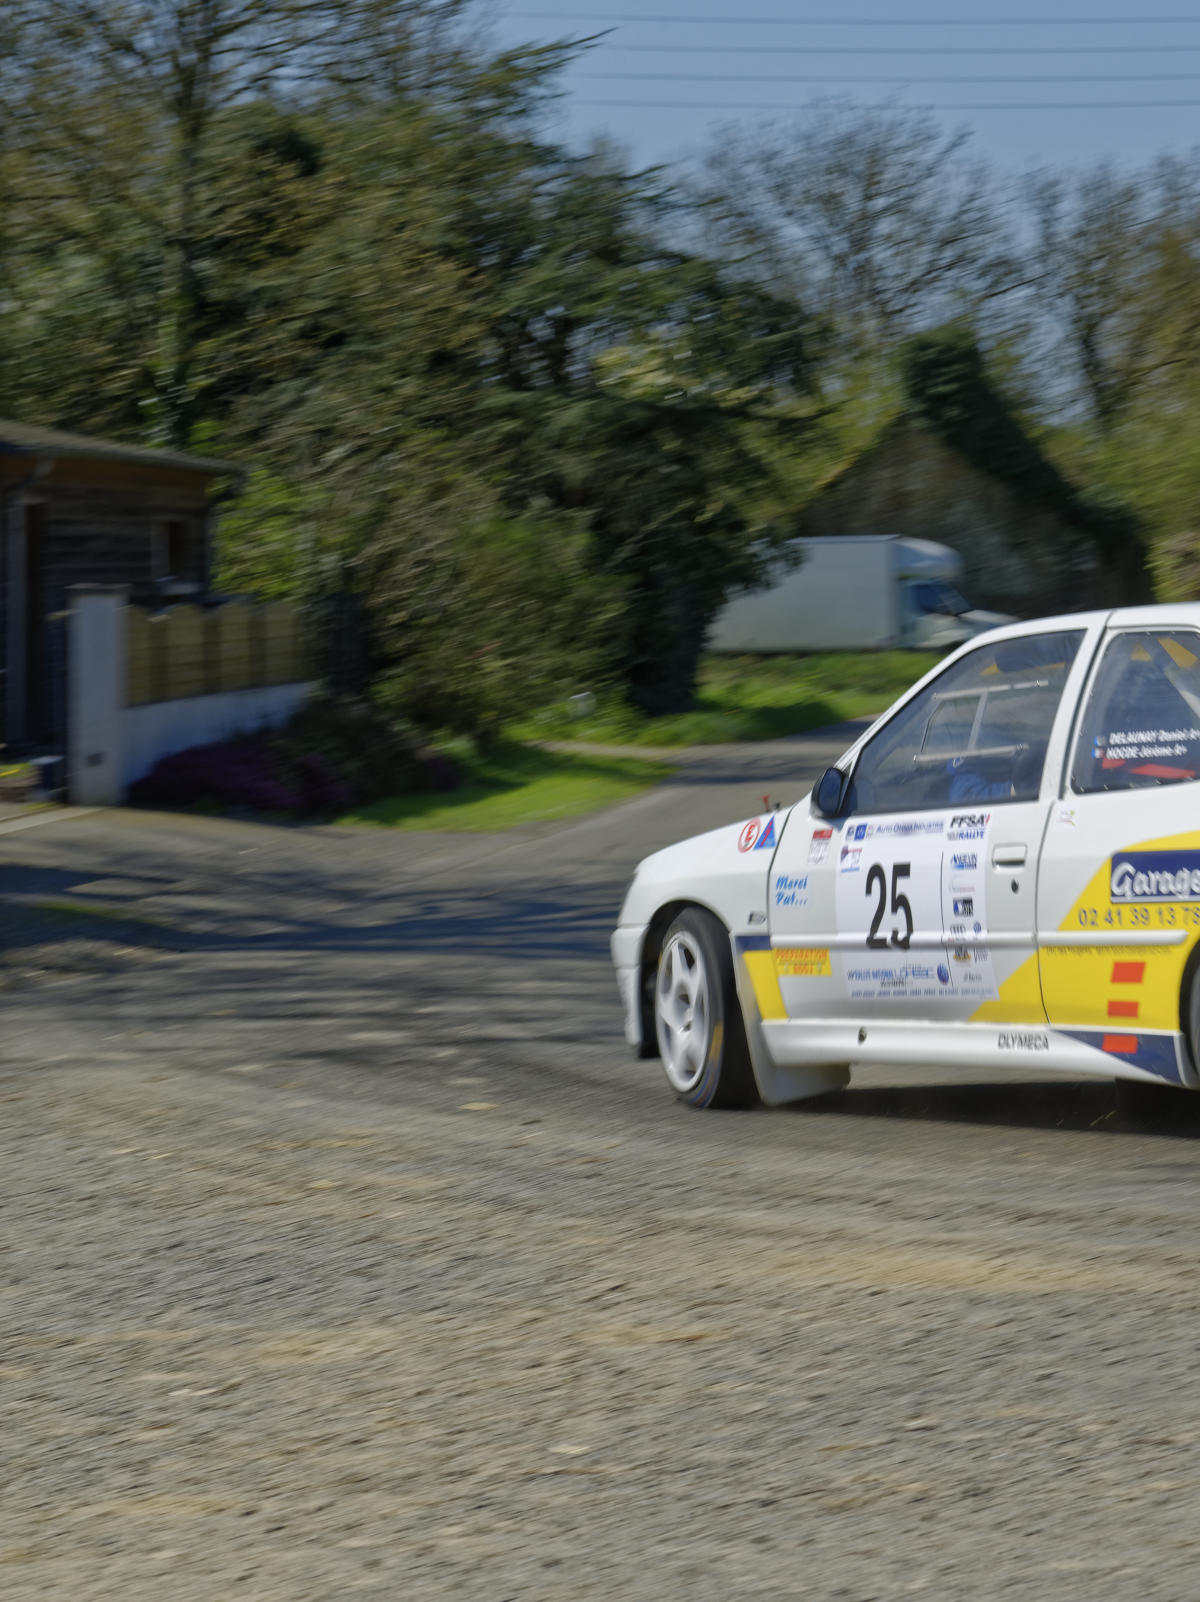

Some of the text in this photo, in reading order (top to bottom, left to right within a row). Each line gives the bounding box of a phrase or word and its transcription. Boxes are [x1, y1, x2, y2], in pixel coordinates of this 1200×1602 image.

[865, 861, 914, 949] 25
[1078, 909, 1099, 927] 02
[1104, 908, 1122, 926] 41
[1130, 907, 1149, 926] 39
[1157, 906, 1176, 926] 13
